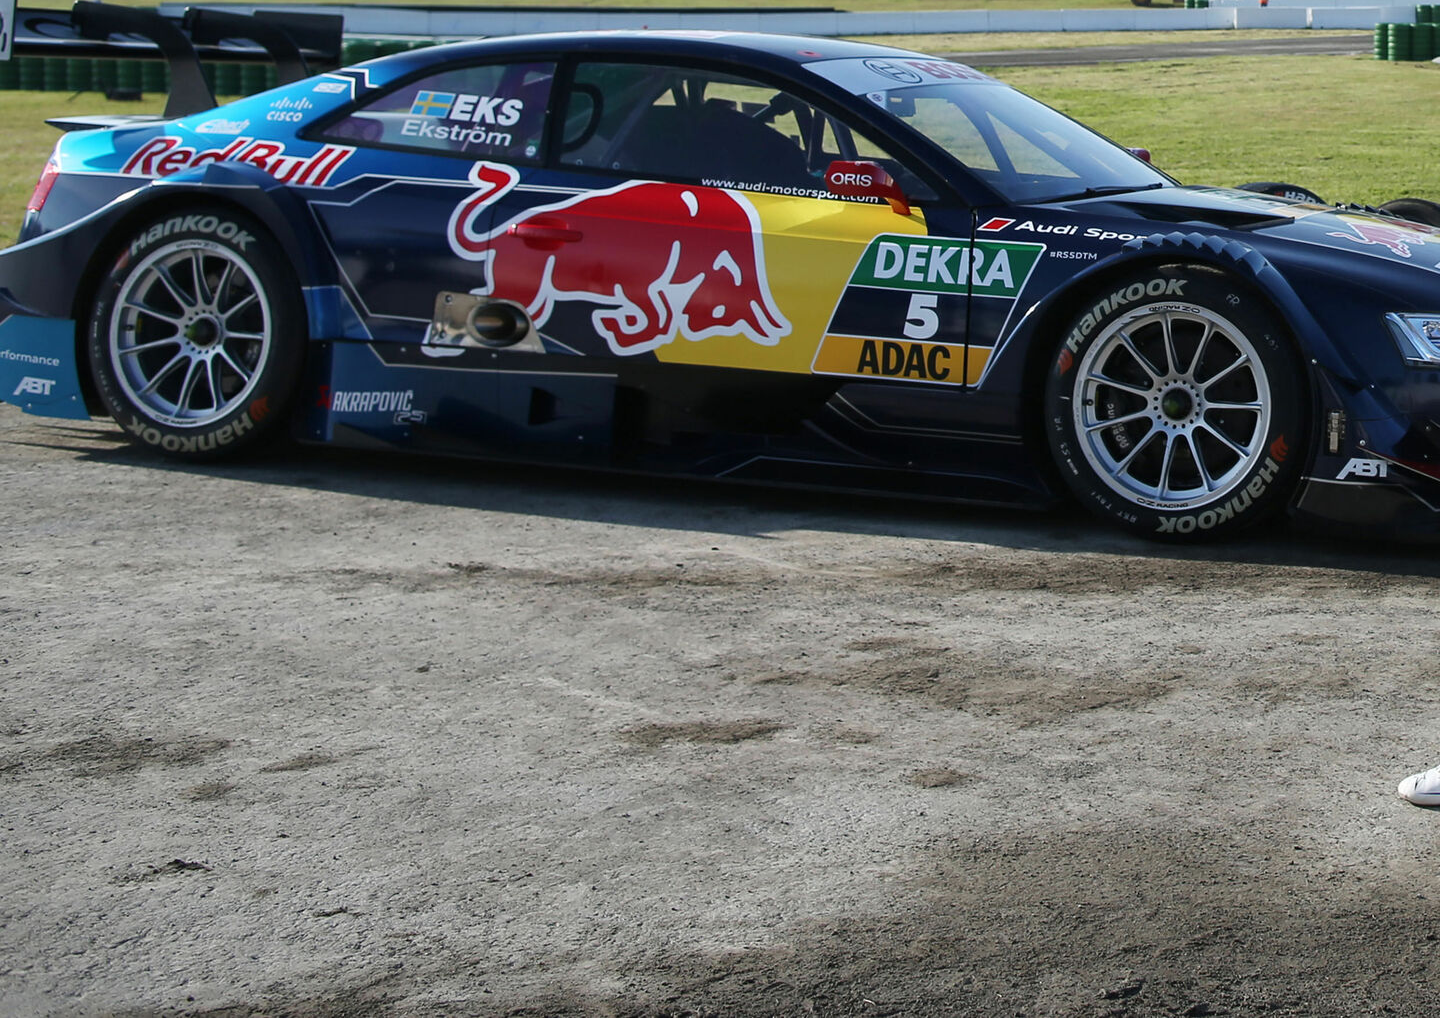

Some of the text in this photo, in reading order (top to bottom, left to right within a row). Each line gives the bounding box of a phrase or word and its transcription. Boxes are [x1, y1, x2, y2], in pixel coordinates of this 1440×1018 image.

[450, 94, 523, 126] EKS
[401, 119, 512, 147] Ekström
[119, 136, 357, 187] Red Bull
[831, 172, 873, 187] ORIS
[1014, 220, 1078, 235] Audi
[873, 242, 1014, 288] DEKRA
[903, 293, 940, 340] 5
[0, 350, 60, 366] rformance
[857, 340, 951, 380] ADAC
[13, 376, 56, 395] ABT
[1336, 458, 1388, 479] ABT
